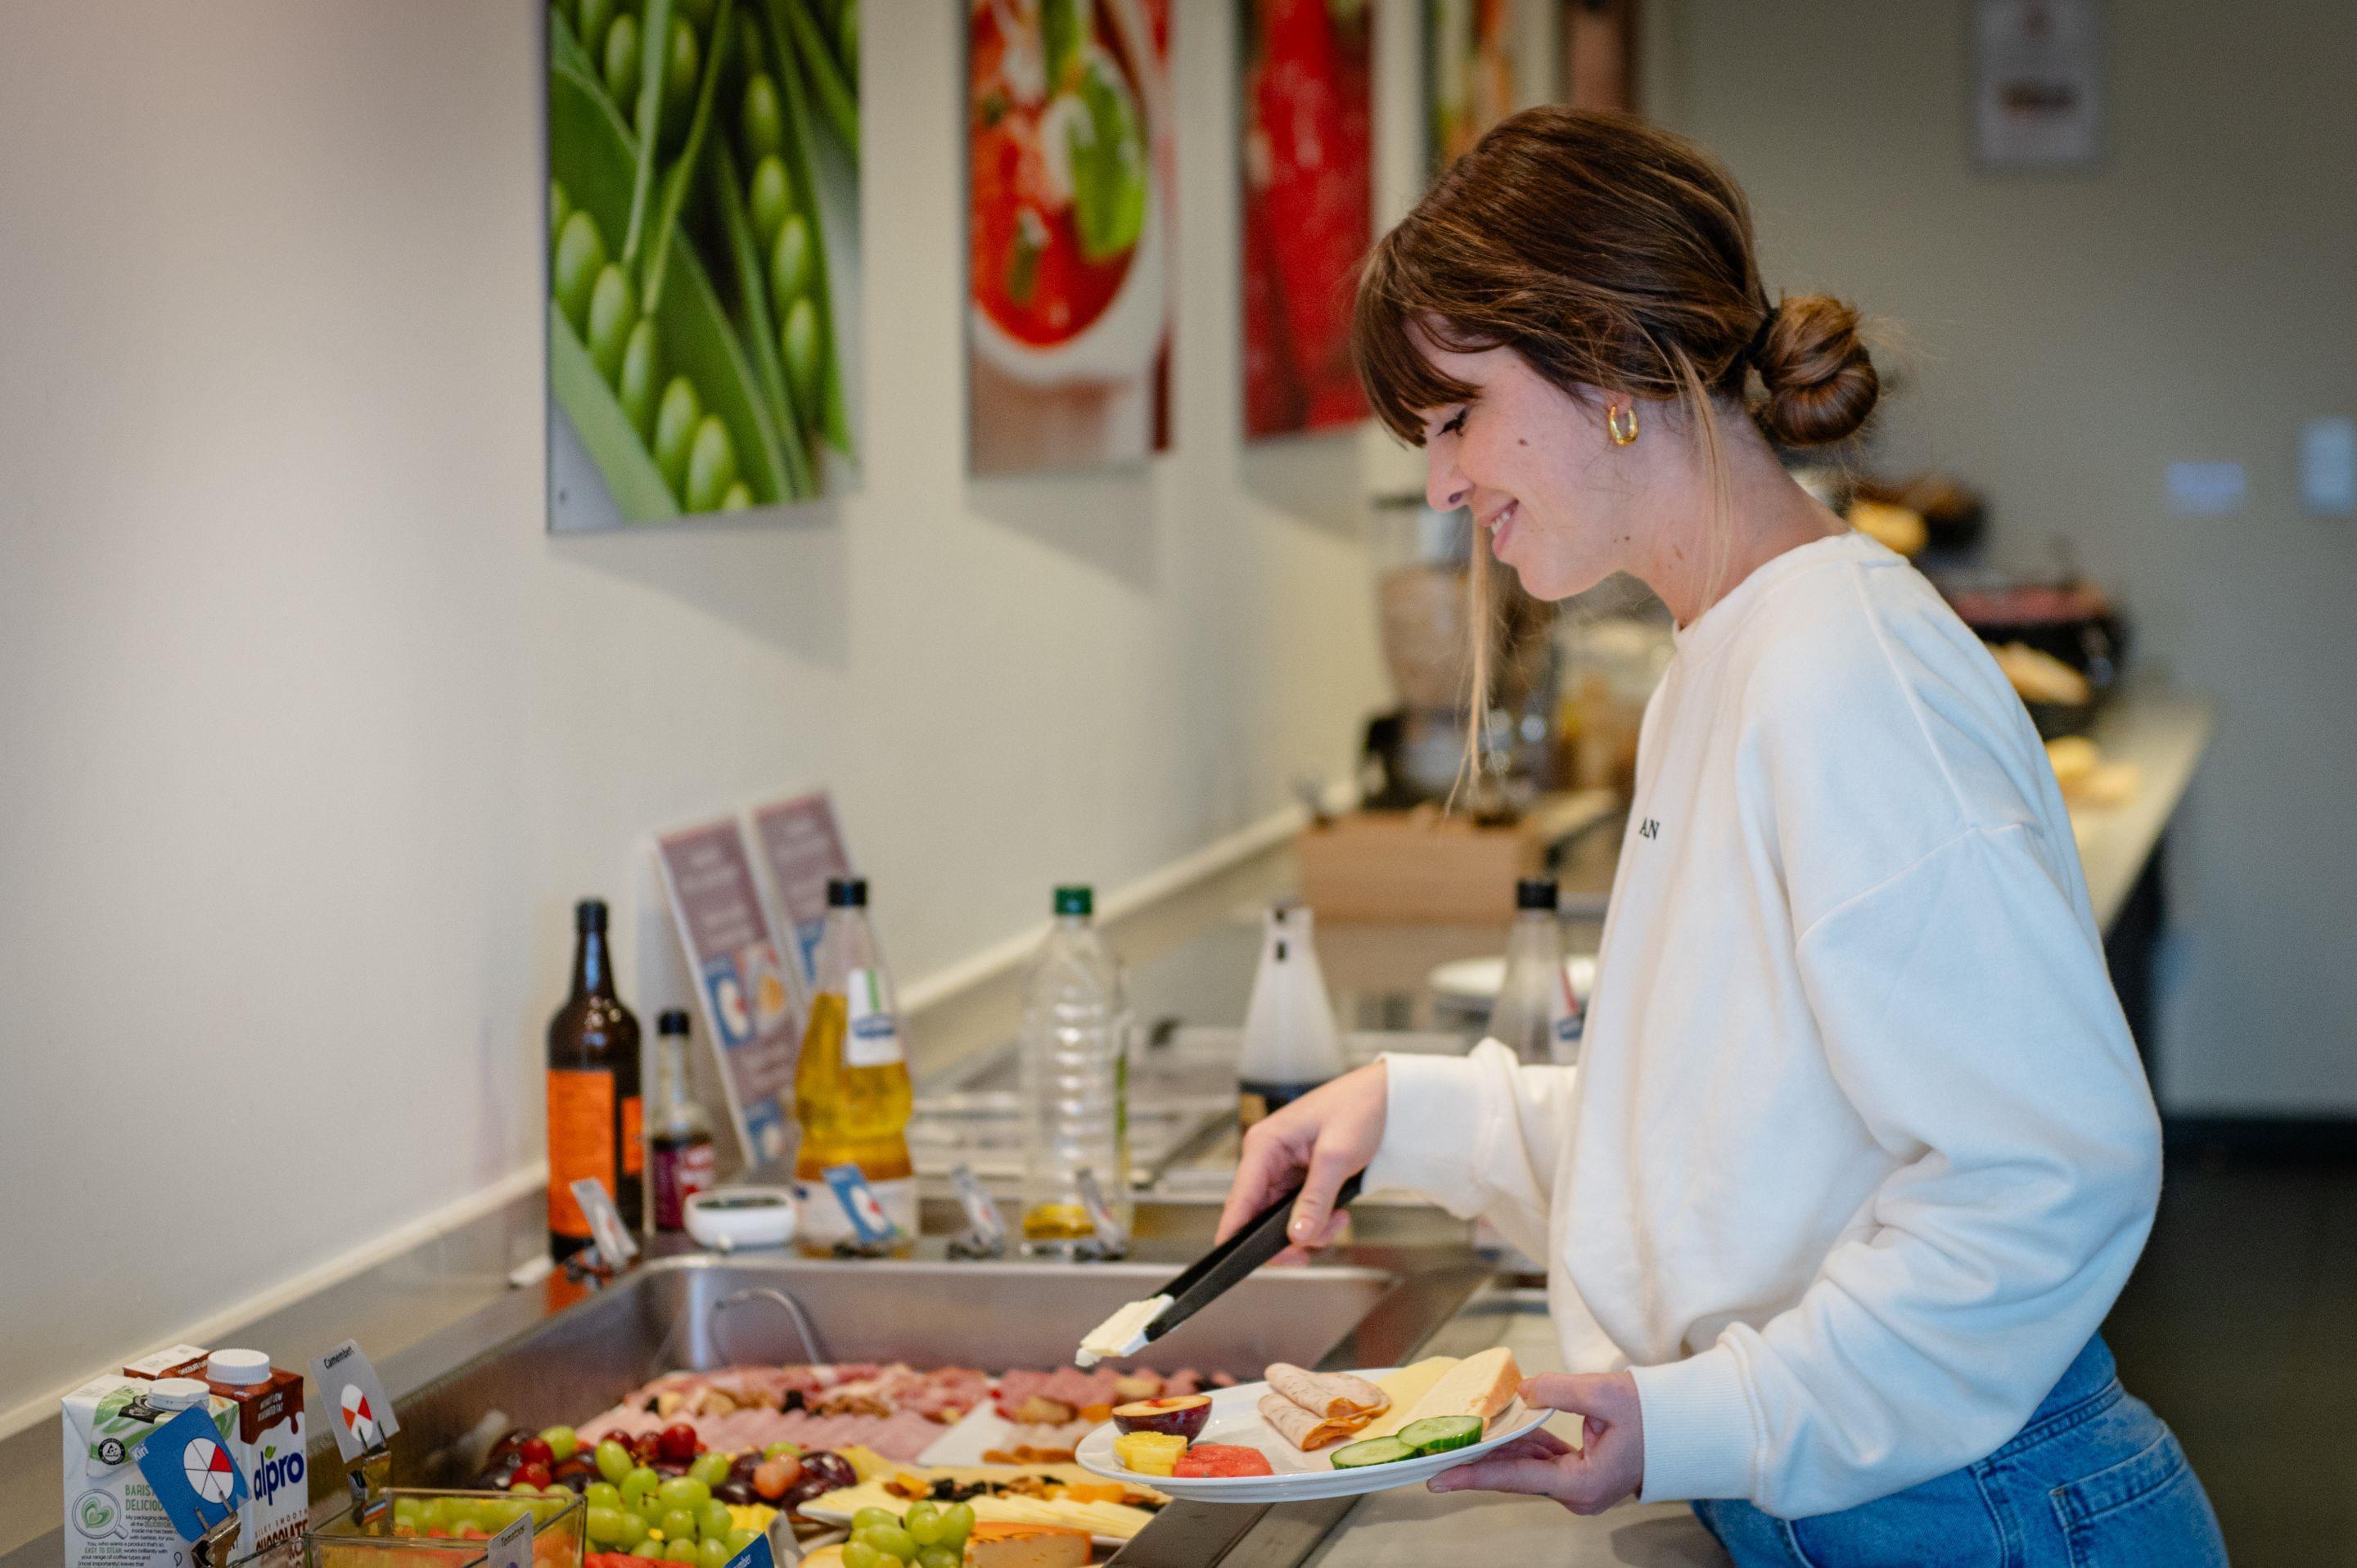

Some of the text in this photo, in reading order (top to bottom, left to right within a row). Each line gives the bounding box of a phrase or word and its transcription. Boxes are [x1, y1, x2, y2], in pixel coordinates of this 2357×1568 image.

[1639, 817, 1660, 840] AN
[323, 1345, 354, 1369] Camembert
[254, 1451, 304, 1506] alpro
[125, 1499, 163, 1512] DELICIOU
